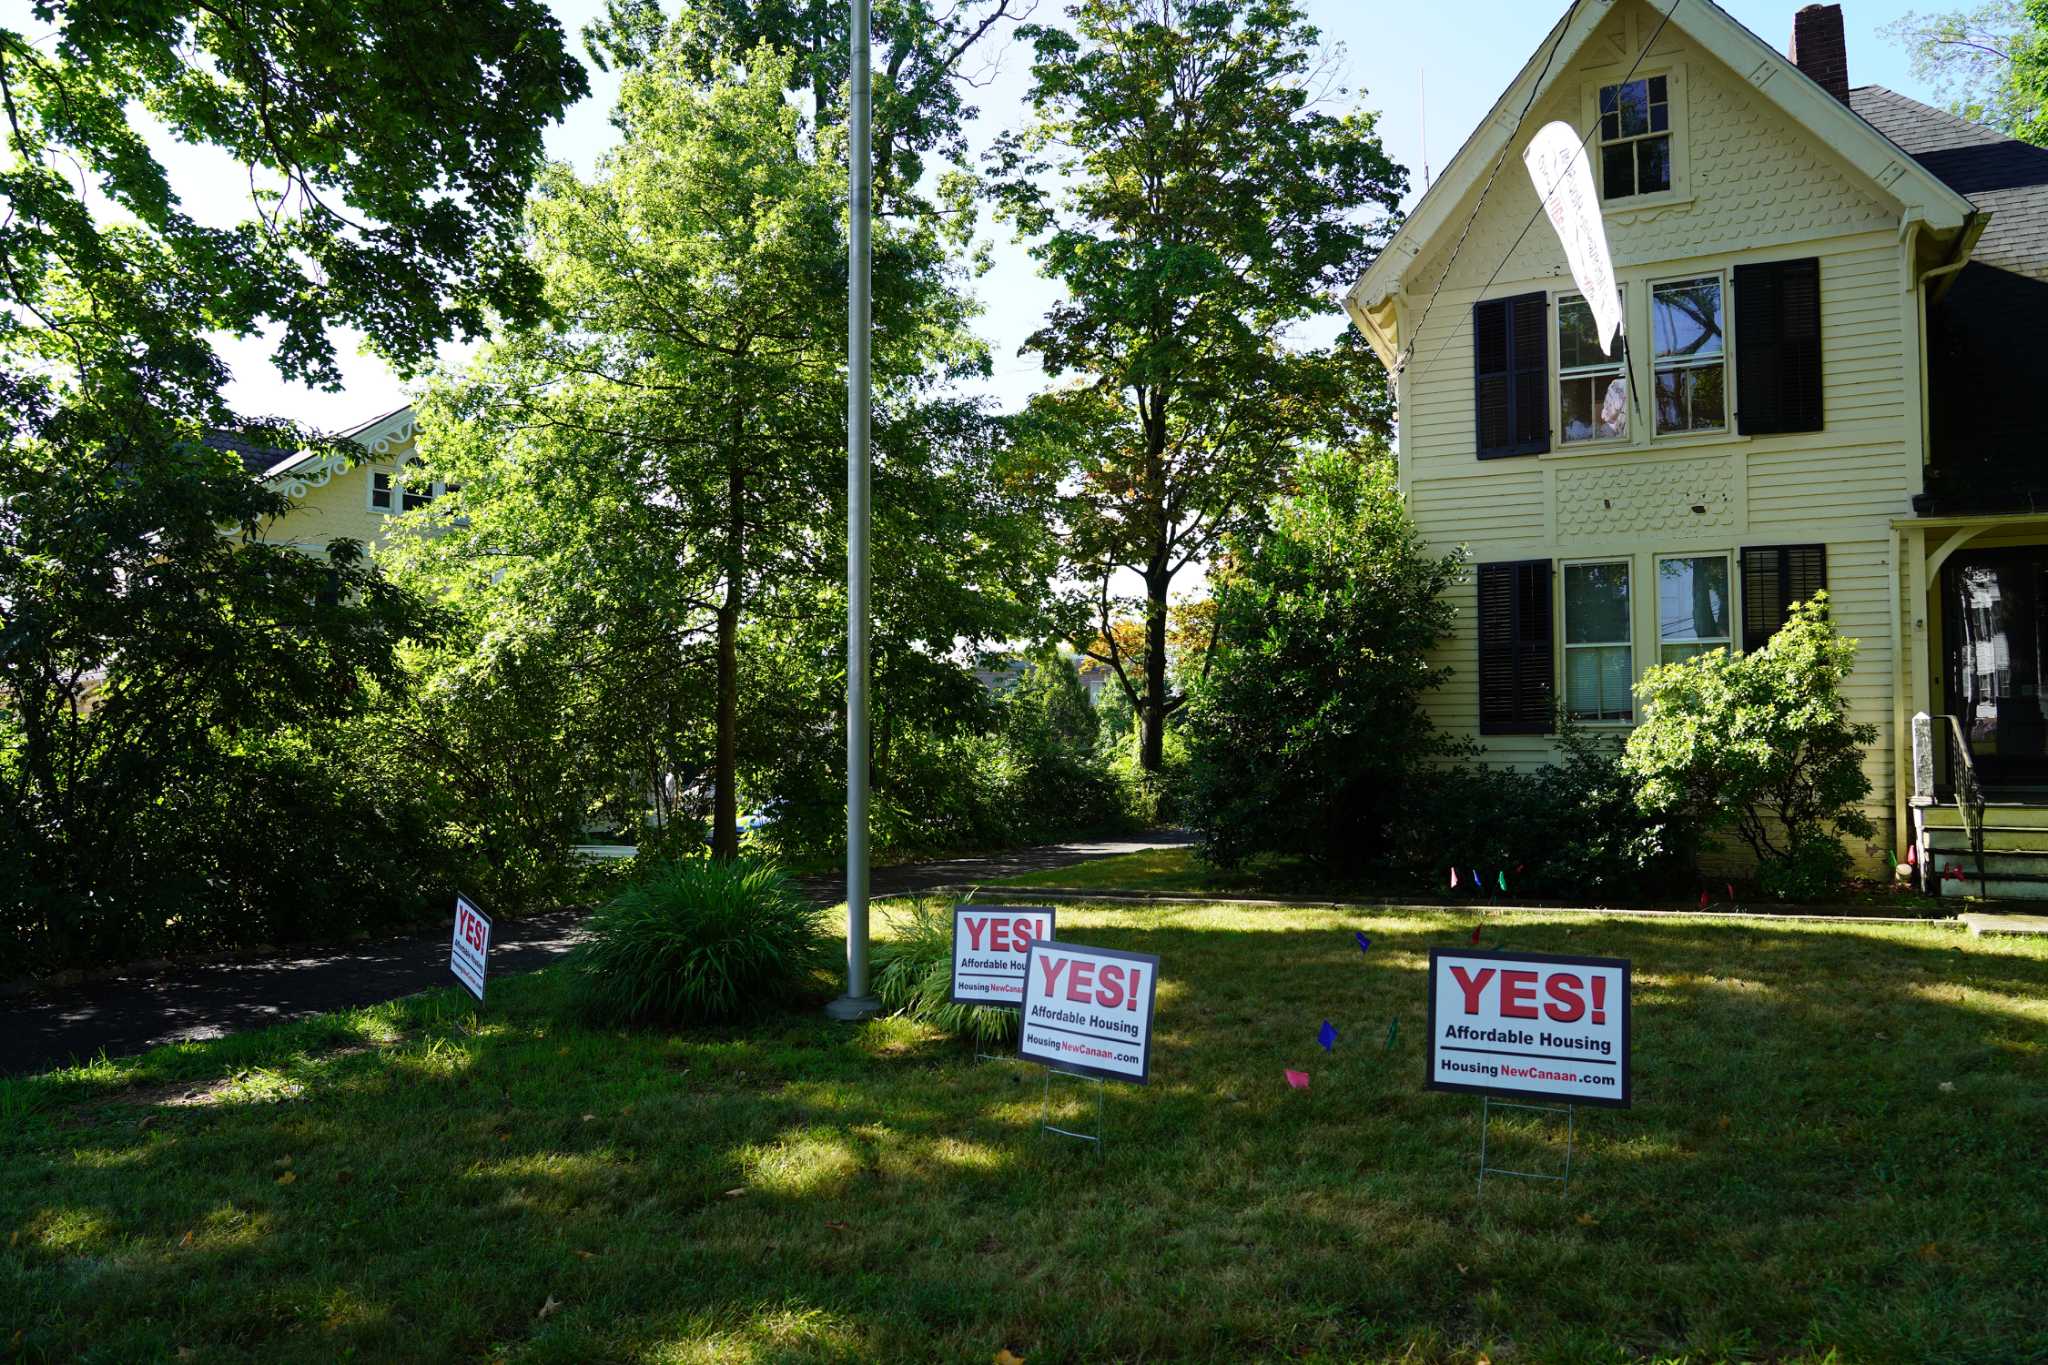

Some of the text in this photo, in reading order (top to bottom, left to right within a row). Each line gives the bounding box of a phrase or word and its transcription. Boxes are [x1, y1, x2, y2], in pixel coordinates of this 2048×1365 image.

[460, 904, 486, 956] YES!
[963, 917, 1043, 953] YES!
[961, 957, 1008, 970] Affordable
[1039, 955, 1142, 1012] YES!
[1449, 965, 1607, 1025] YES!
[1031, 1004, 1139, 1037] Affordable Housing
[1445, 1024, 1612, 1055] Affordable Housing
